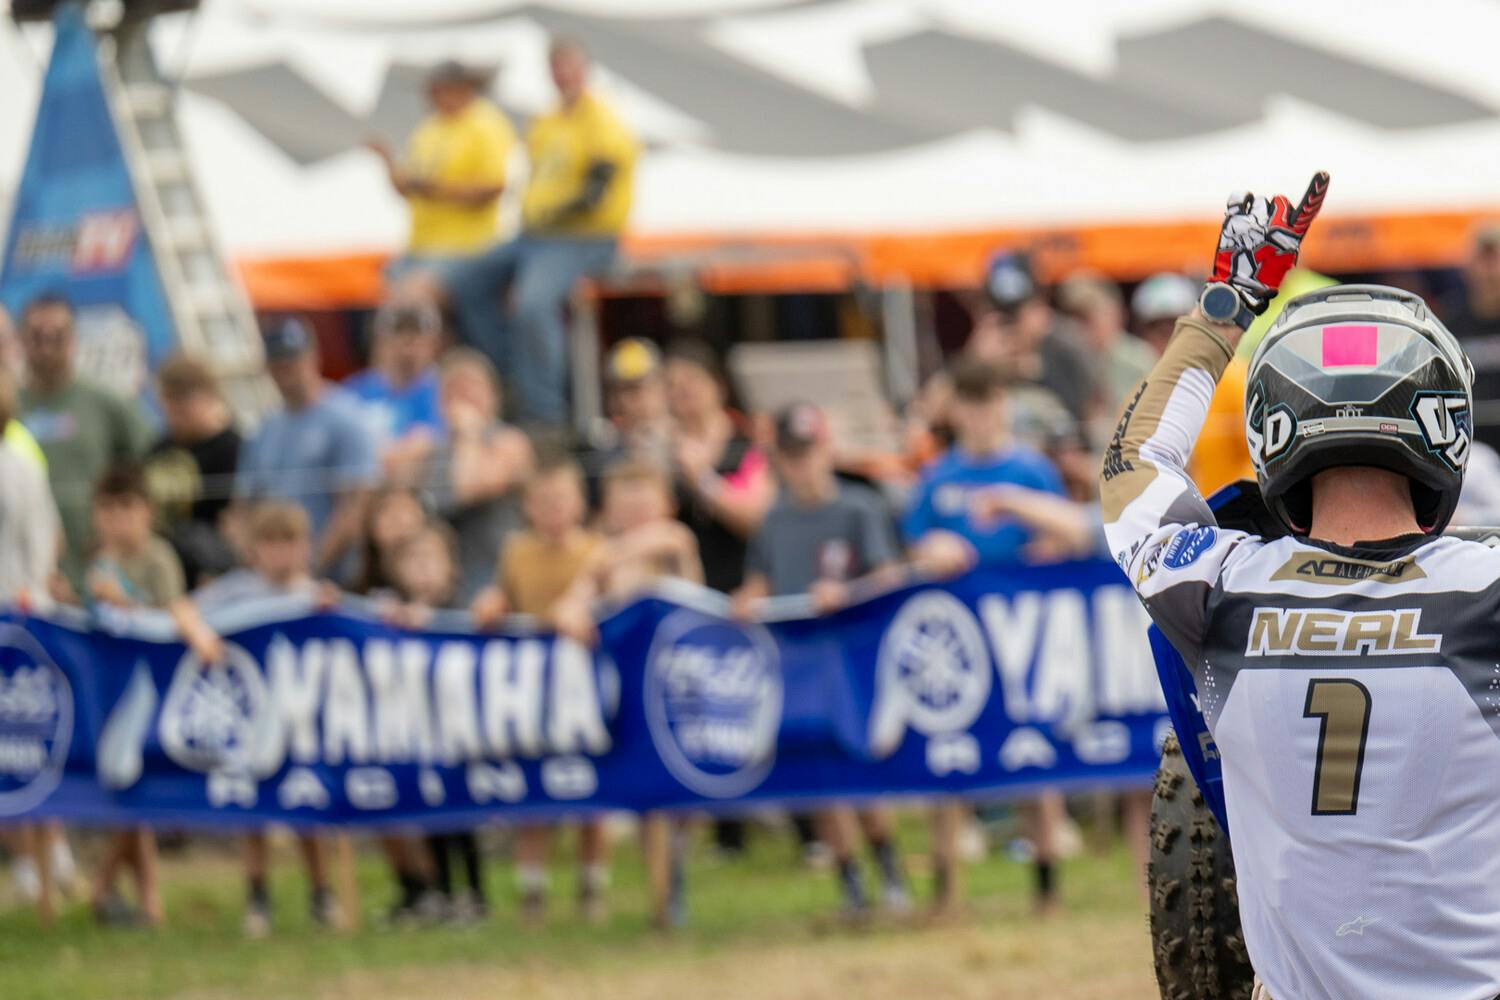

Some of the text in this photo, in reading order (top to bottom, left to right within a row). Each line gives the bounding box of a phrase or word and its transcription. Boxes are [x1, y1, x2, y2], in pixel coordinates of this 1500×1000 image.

[976, 584, 1170, 722] YAM
[1245, 607, 1443, 656] NEAL
[270, 636, 613, 764] YAMAHA
[1303, 678, 1374, 816] 1
[208, 757, 600, 809] RACING
